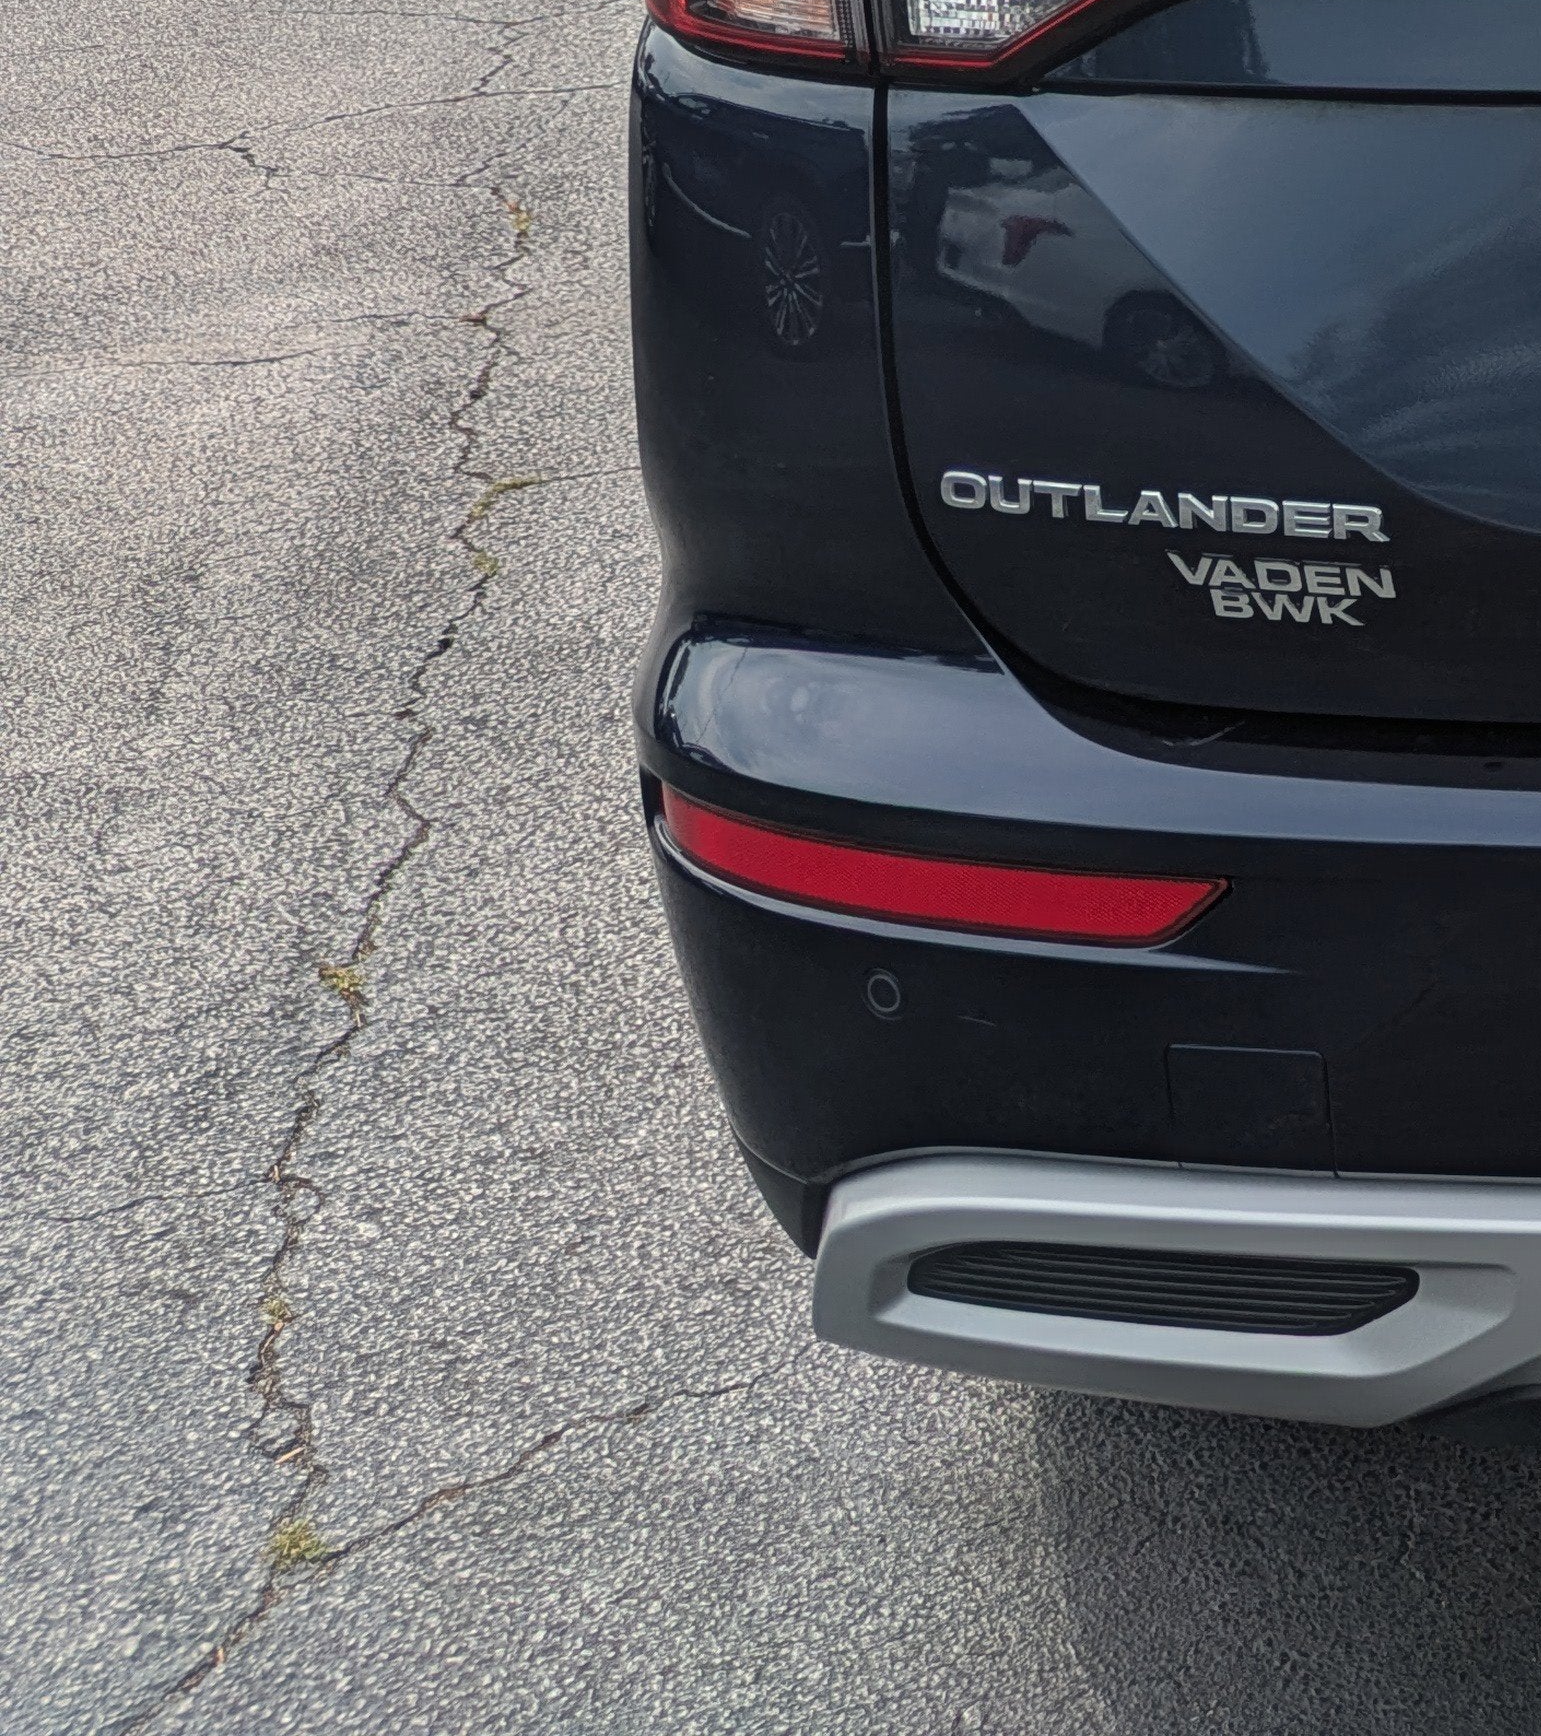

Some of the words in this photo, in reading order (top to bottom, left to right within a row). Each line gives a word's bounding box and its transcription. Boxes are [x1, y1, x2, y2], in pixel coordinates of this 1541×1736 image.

[940, 470, 1390, 542] OUTLANDER
[1165, 549, 1397, 599] VADEN
[1209, 587, 1365, 627] BWK
